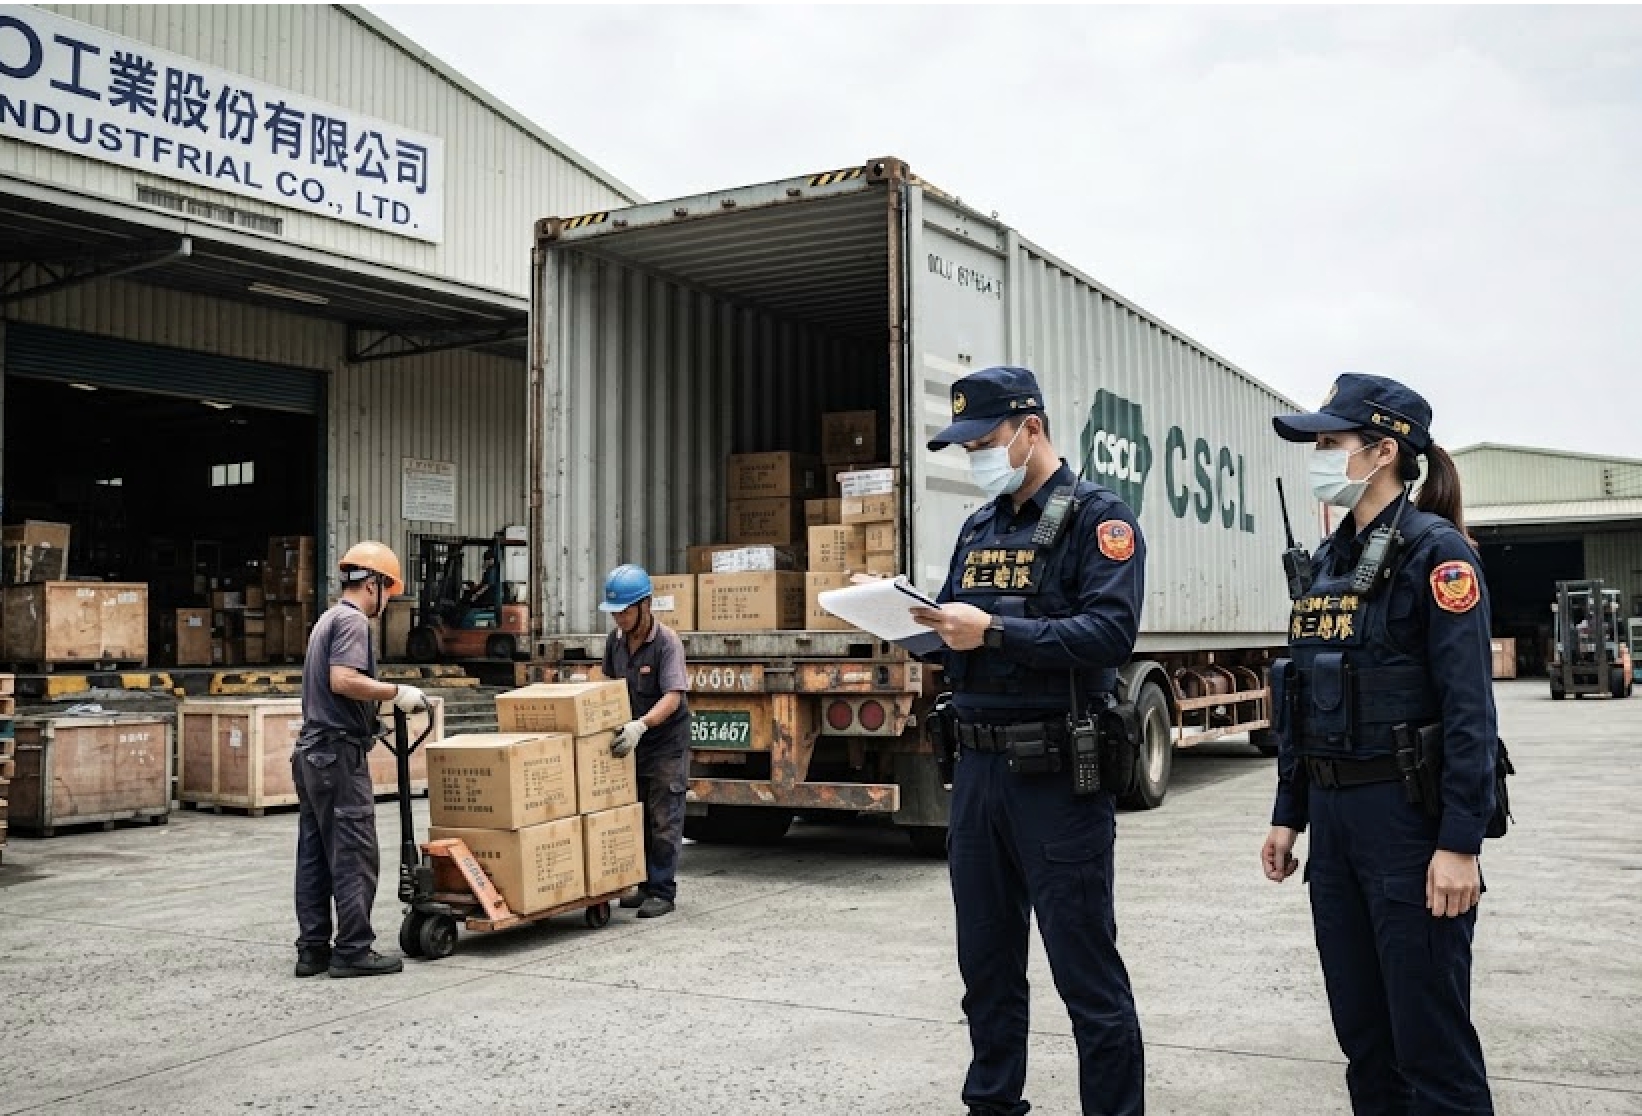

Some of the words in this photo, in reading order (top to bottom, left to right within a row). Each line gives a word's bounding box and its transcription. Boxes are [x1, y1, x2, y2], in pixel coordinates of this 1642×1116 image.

[356, 191, 419, 229] LTD.
[1093, 429, 1142, 483] CSCL
[1165, 425, 1255, 534] CSCL
